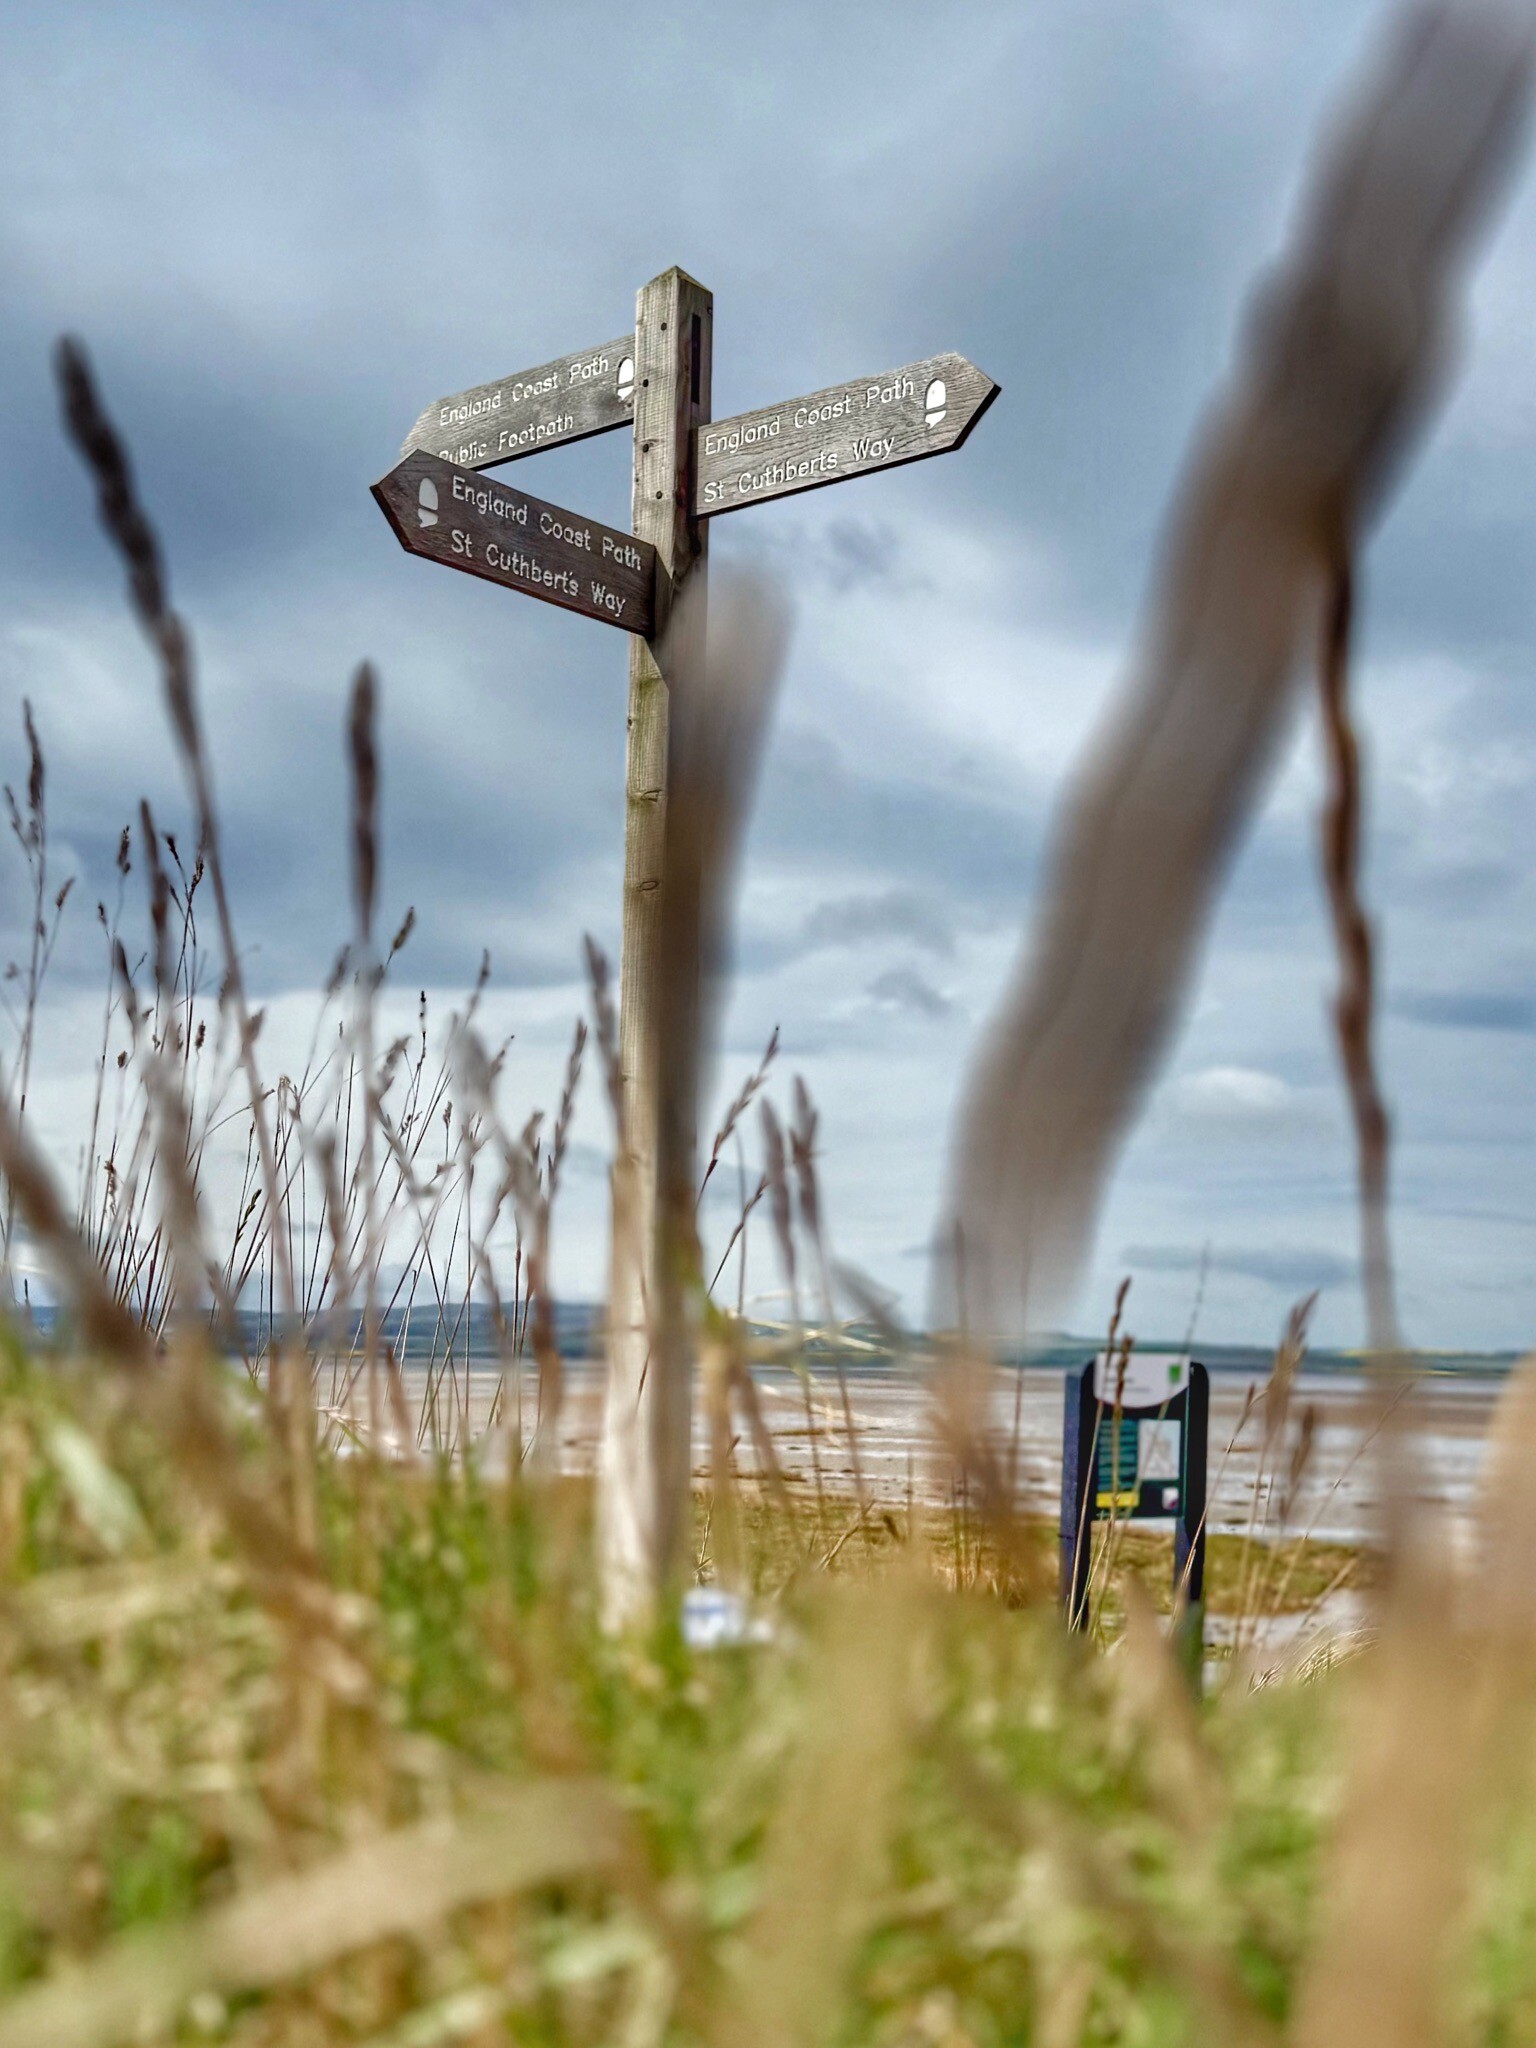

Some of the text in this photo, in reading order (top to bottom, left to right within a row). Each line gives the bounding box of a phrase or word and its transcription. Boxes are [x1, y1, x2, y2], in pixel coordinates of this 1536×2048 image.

[439, 356, 609, 426] England Coast Path
[704, 377, 914, 456] England Coast Path
[498, 413, 574, 451] Footpath
[703, 481, 724, 502] St
[852, 435, 895, 461] Way
[452, 475, 641, 571] England Coast Path
[451, 530, 472, 558] St
[591, 581, 626, 617] Way
